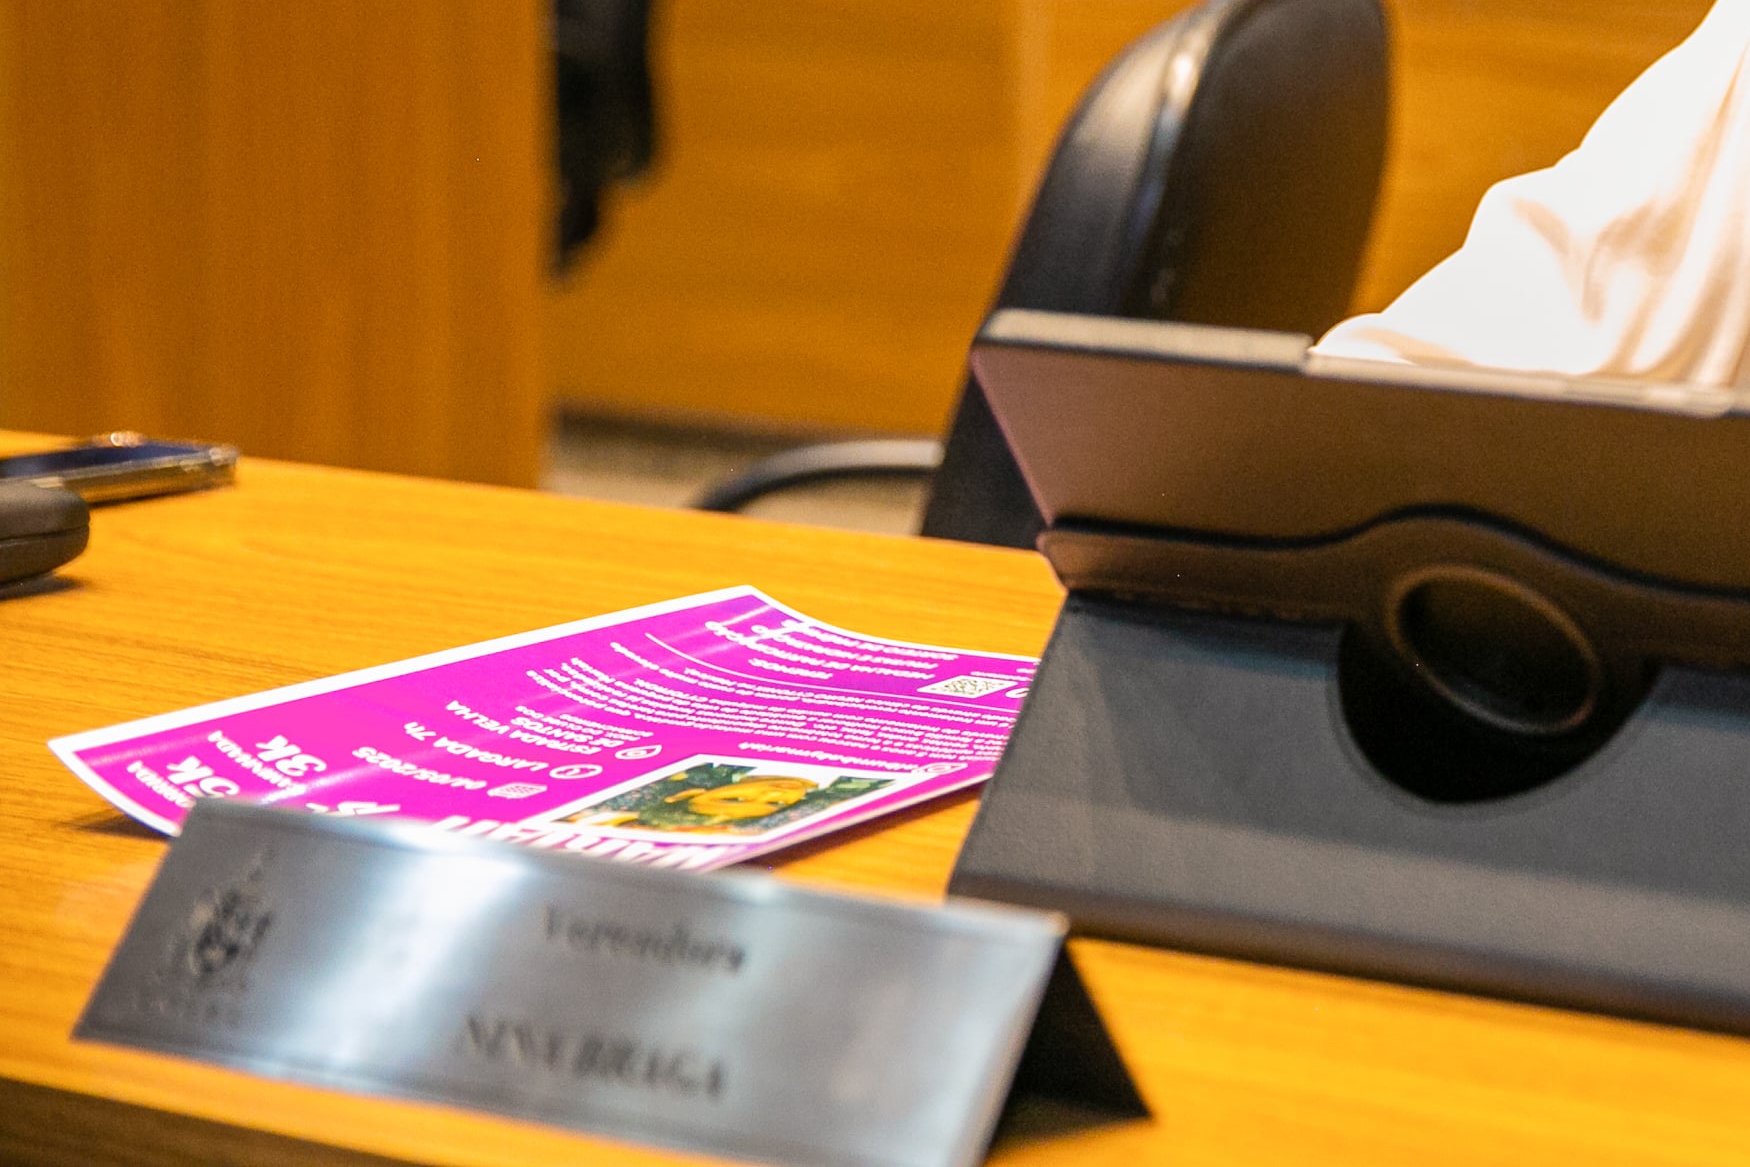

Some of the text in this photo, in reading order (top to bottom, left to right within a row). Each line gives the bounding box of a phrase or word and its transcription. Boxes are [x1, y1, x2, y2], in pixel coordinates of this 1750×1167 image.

[404, 722, 549, 771] LARGADA 7h
[446, 700, 601, 754] ESTRADA VELHA
[510, 717, 624, 747] DE SANTOS
[256, 735, 327, 776] 3k
[352, 747, 487, 790] 04/05/2025
[127, 761, 196, 808] ORRIDA
[167, 756, 240, 800] 5k
